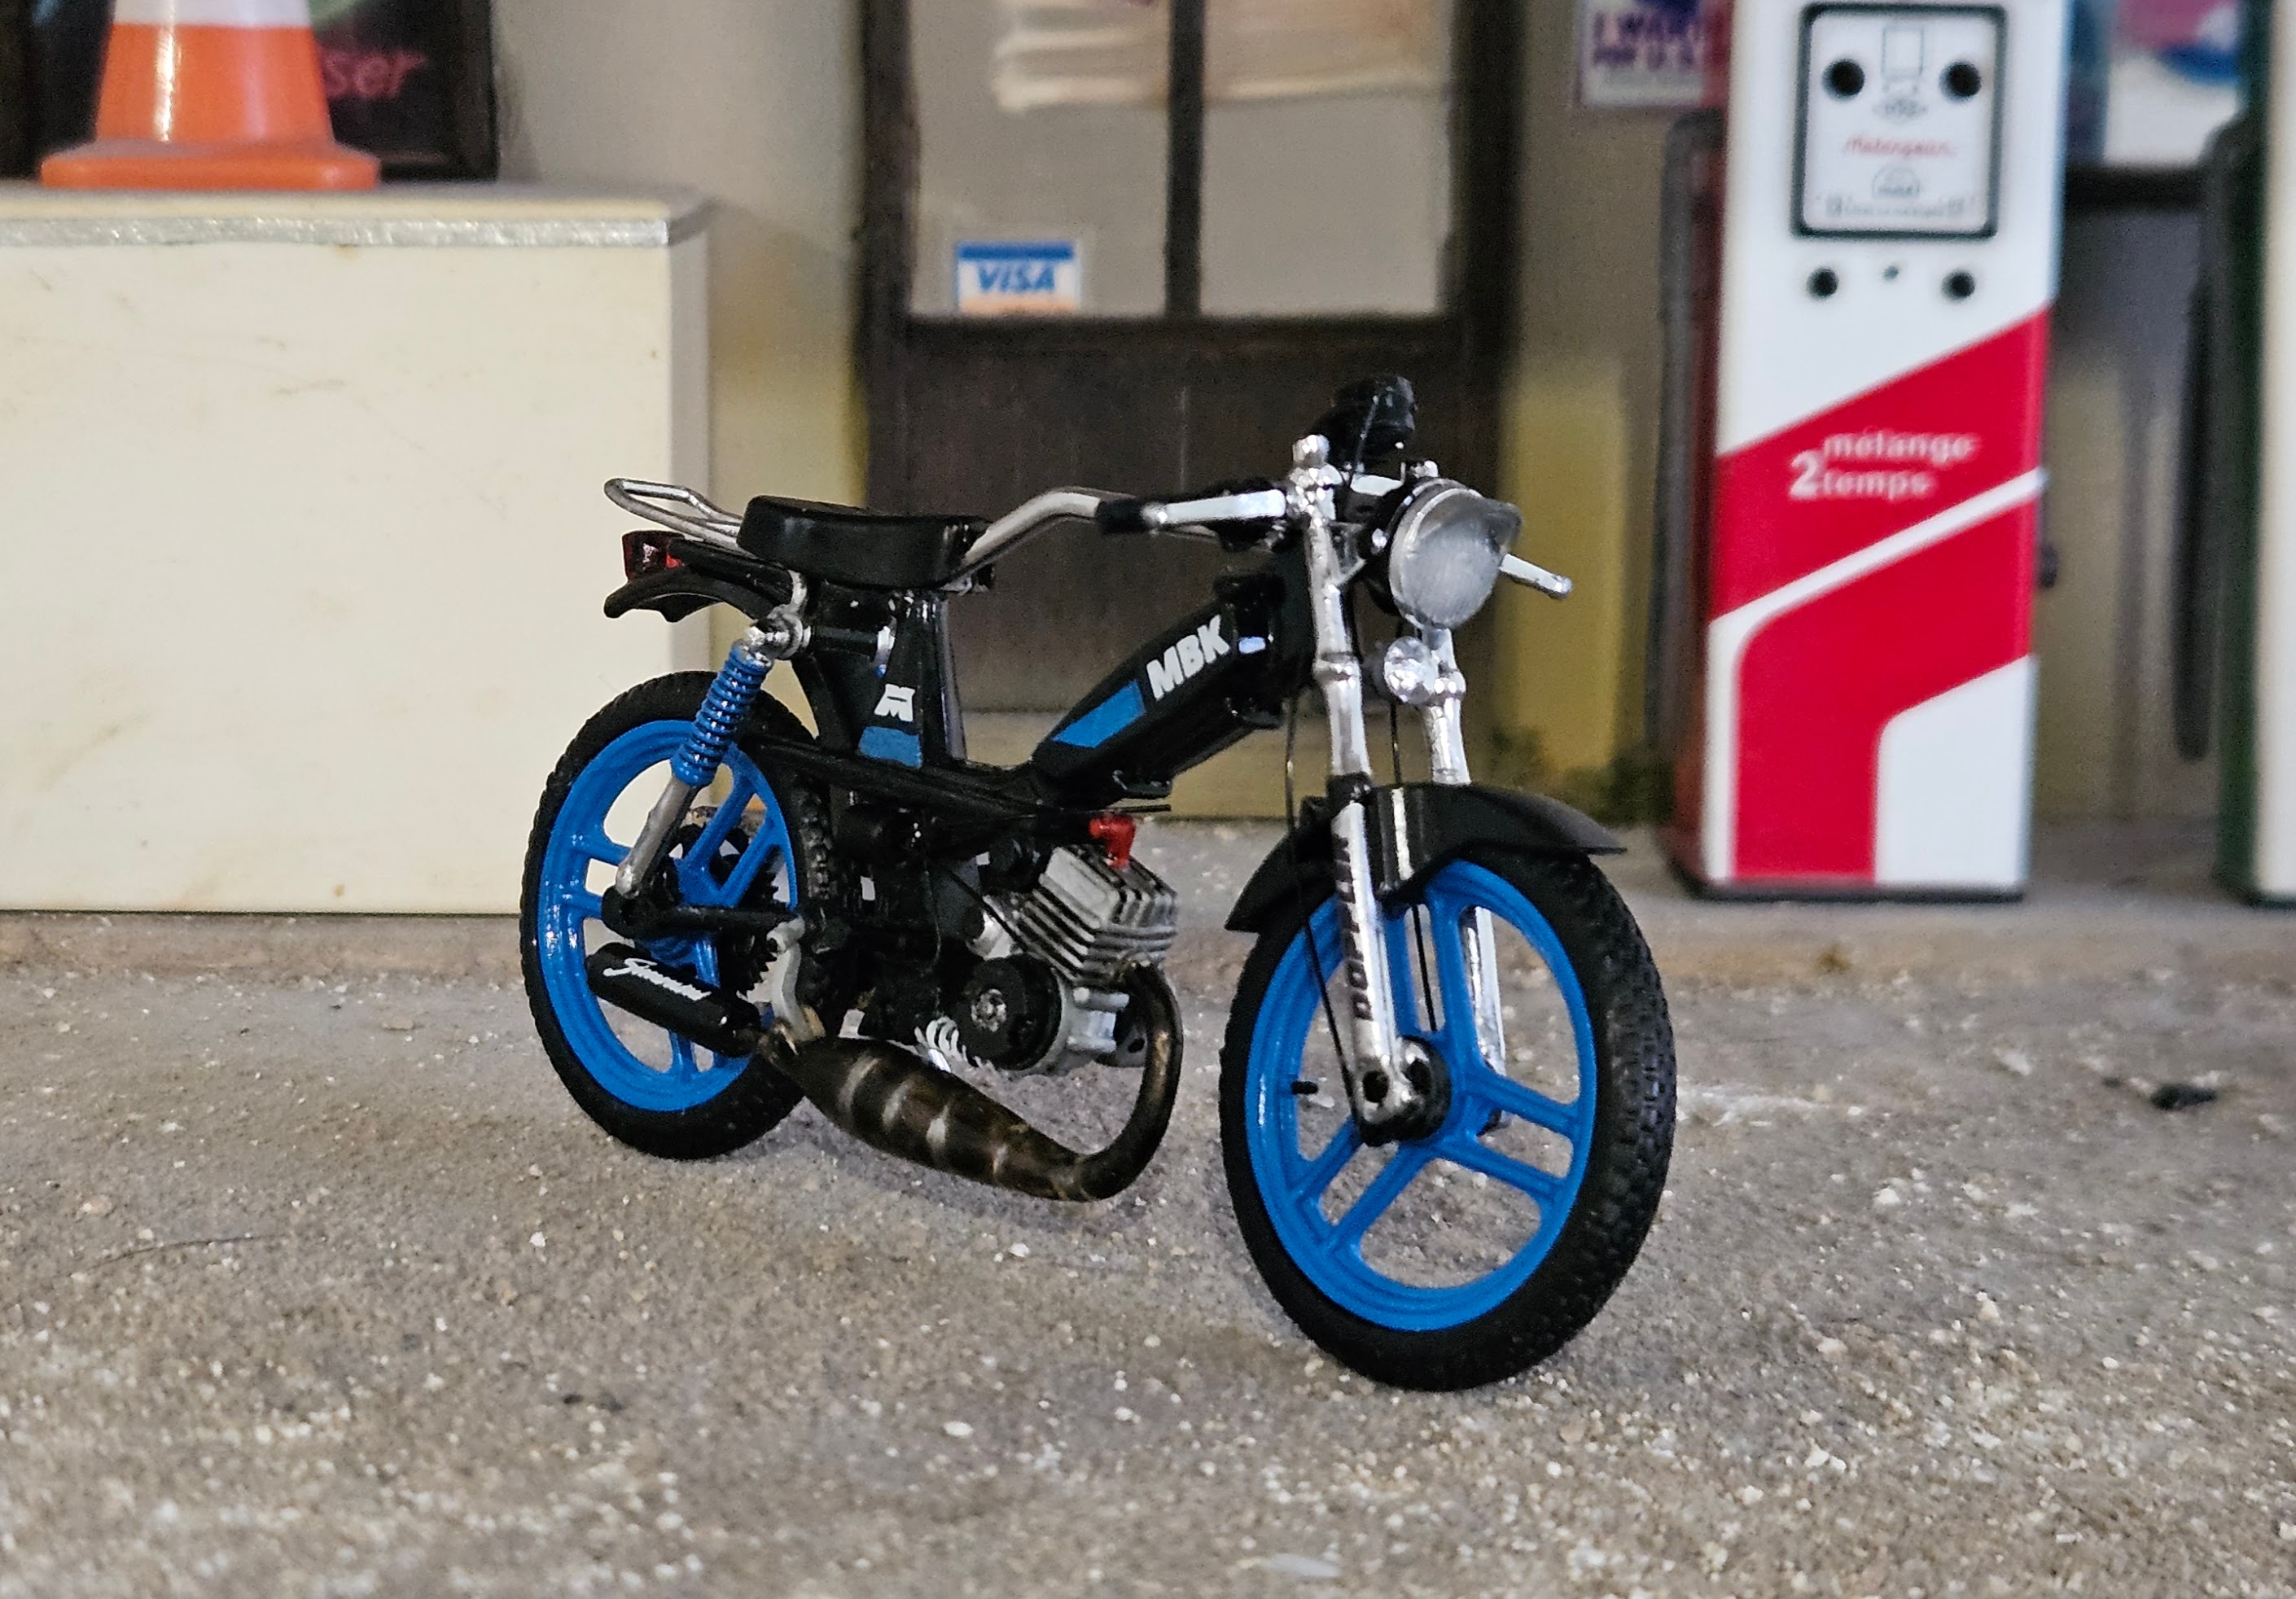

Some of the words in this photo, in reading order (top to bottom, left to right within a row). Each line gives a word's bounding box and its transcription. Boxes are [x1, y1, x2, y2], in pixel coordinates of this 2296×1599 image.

[979, 264, 1056, 292] VISA
[1825, 429, 1975, 466] mélange
[1790, 449, 1819, 498] 2
[1824, 471, 1931, 501] temps
[1146, 615, 1229, 700] MBK
